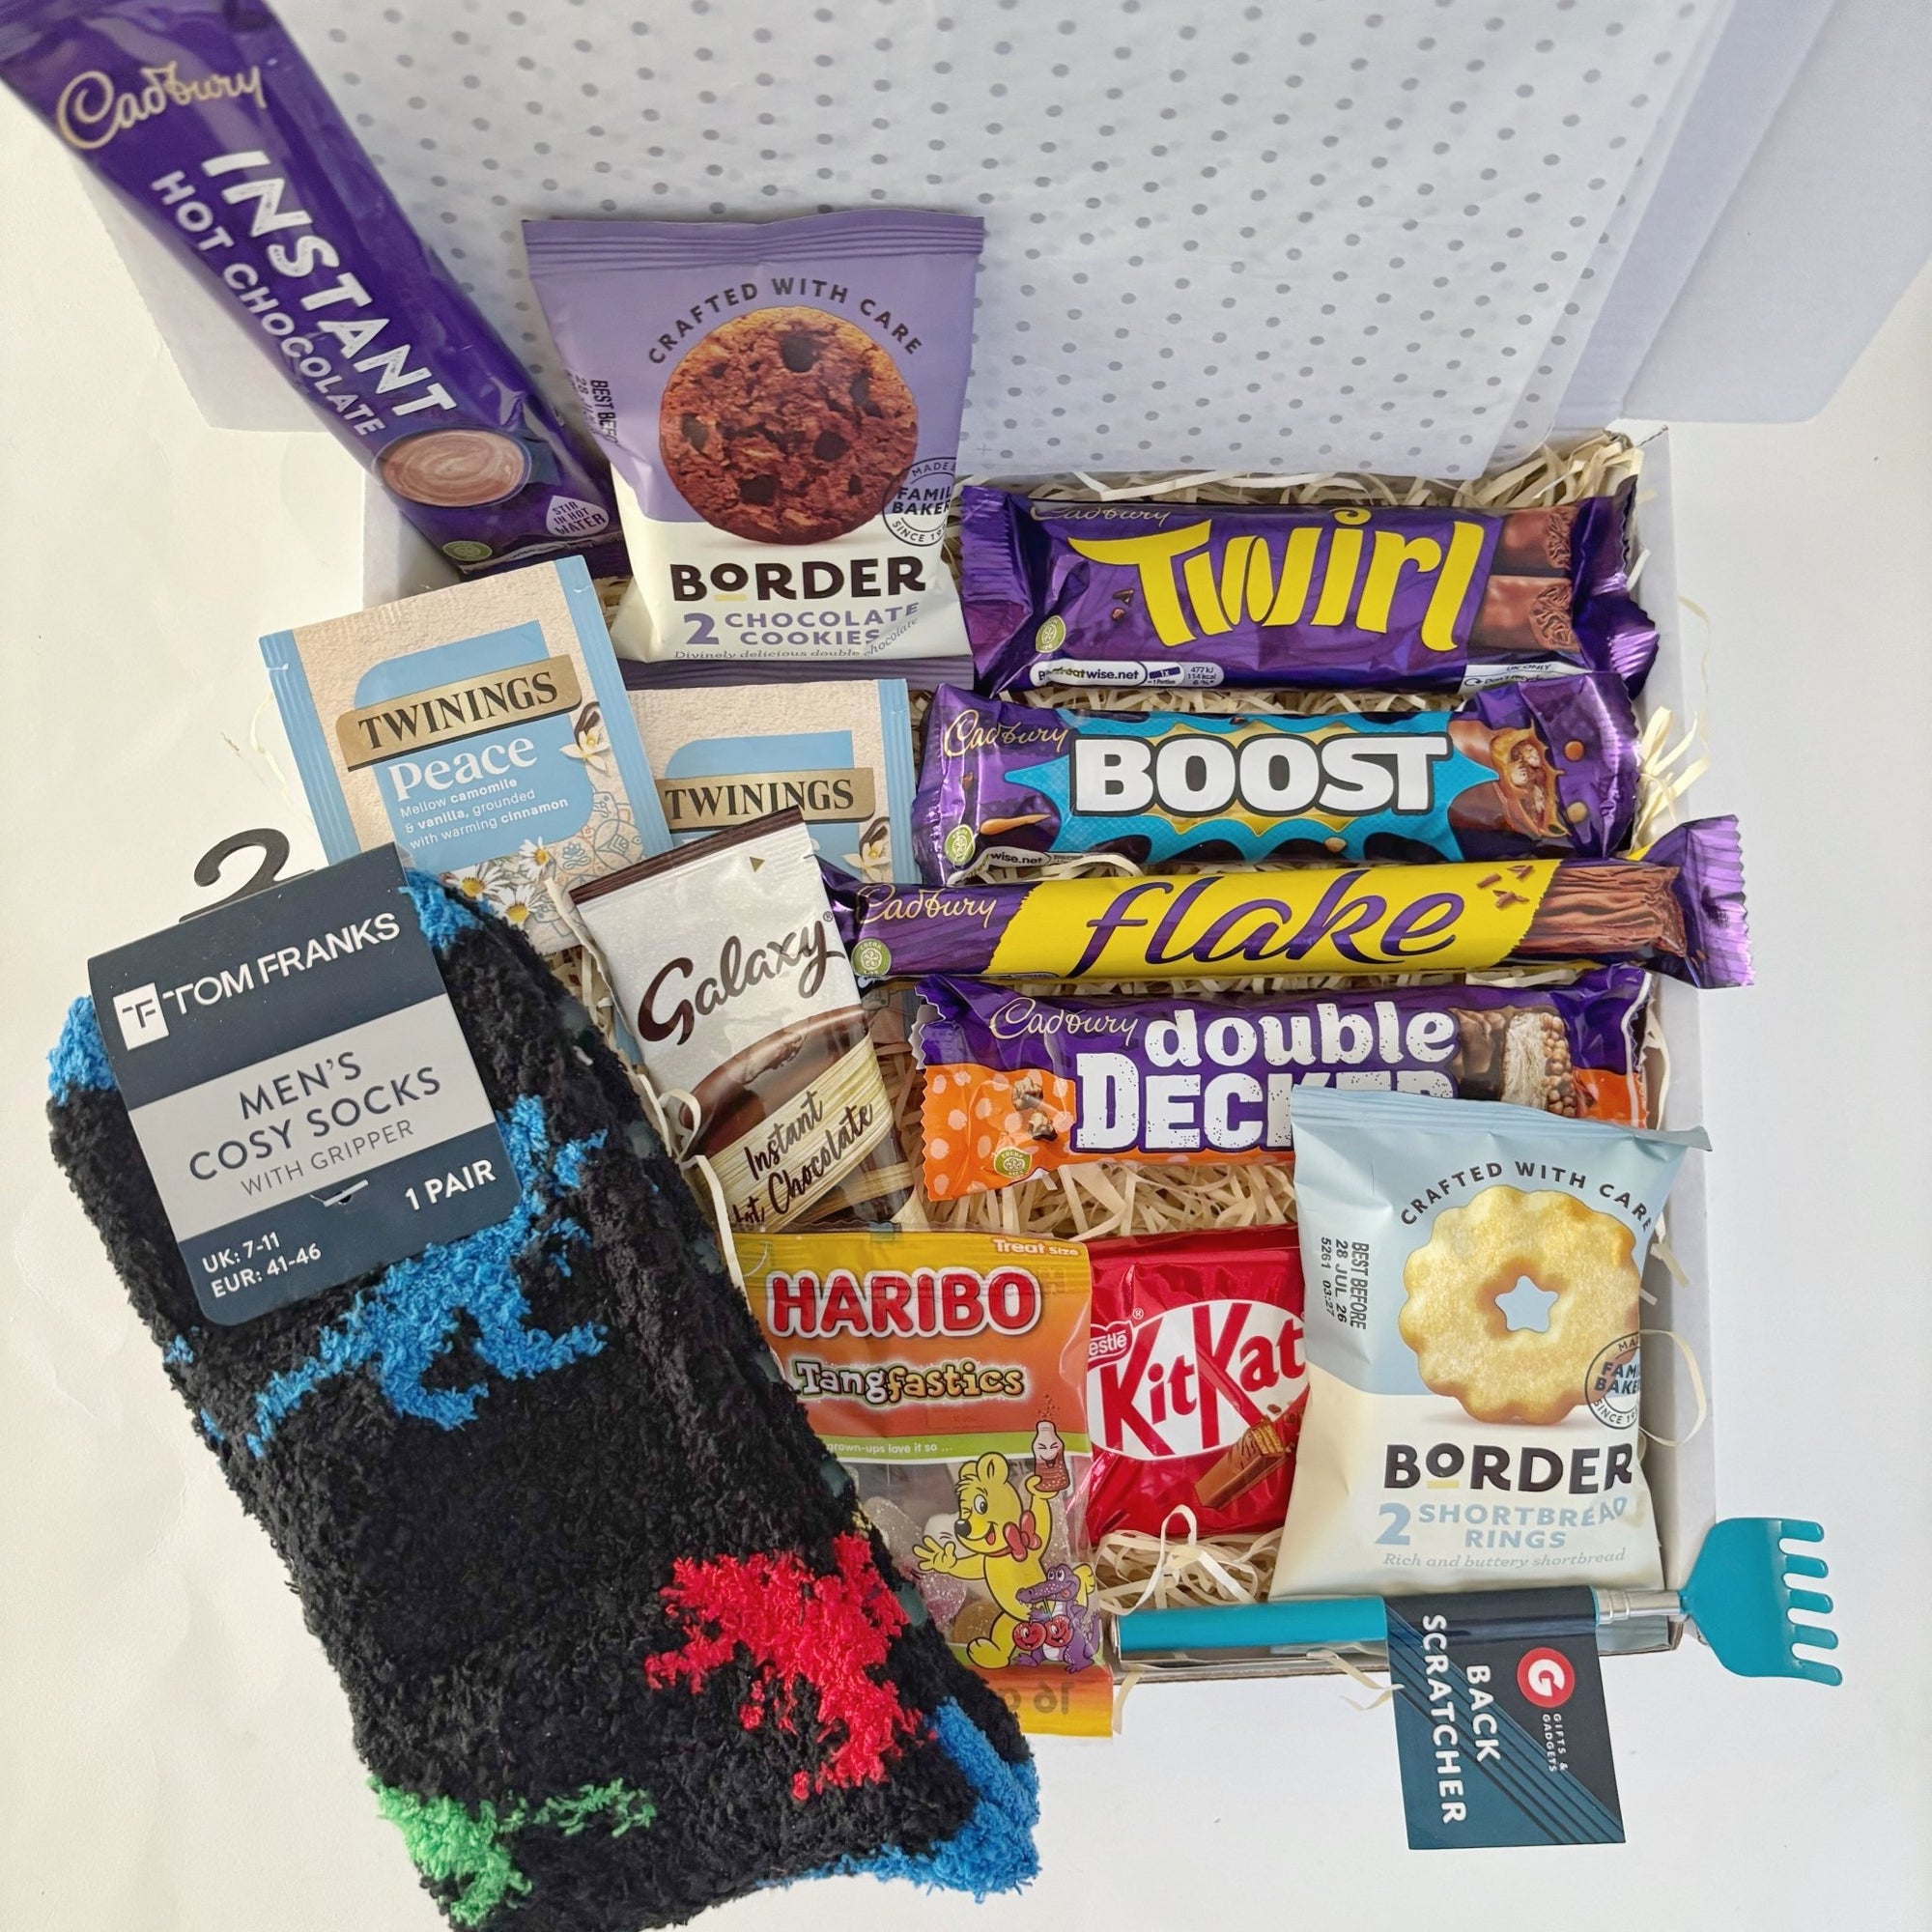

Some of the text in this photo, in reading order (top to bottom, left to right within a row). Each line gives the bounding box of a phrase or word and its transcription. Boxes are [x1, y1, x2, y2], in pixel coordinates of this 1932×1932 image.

[56, 62, 266, 150] Cadbury
[152, 171, 385, 436] HOT CHOCOLATE
[201, 151, 456, 417] INSTANT
[648, 277, 923, 365] CRAFTED WITH CARE
[590, 380, 613, 409] BEST
[912, 462, 949, 477] MADE
[553, 501, 579, 516] STIR
[554, 507, 590, 526] IN HOT
[554, 513, 607, 535] WATER
[892, 520, 925, 542] SINCE
[670, 555, 926, 602] BORDER
[1068, 508, 1484, 653] Twirl
[683, 611, 720, 645] 2
[724, 602, 920, 628] CHOCOLATE
[740, 629, 880, 645] COOKIES
[674, 650, 736, 660] Divinely
[740, 649, 808, 659] delicious
[810, 648, 861, 658] double
[358, 671, 559, 752] TWININGS
[944, 709, 1069, 757] Cadbury
[388, 737, 538, 802] Peace
[1073, 736, 1450, 812] BOOST
[400, 776, 518, 819] Mellow camomile
[406, 788, 536, 834] & vanilla, grounded
[410, 797, 569, 850] with warming cinnamon
[665, 779, 854, 820] TWININGS
[854, 883, 997, 929] Cadbury
[1065, 869, 1465, 979] flake
[162, 963, 254, 1015] TOM
[257, 912, 401, 984] FRANKS
[637, 918, 846, 1045] Galaxy
[989, 997, 1139, 1046] Cadbury
[1144, 1001, 1457, 1066] double
[239, 1050, 362, 1121] MEN'S
[1075, 1052, 1454, 1150] DECK
[189, 1065, 441, 1180] COSY SOCKS
[744, 1090, 823, 1181] Instant
[241, 1119, 414, 1197] WITH GRIPPER
[767, 1103, 873, 1215] Chocolate
[405, 1159, 497, 1211] 1 PAIR
[1400, 1160, 1503, 1226] CRAFTED
[1515, 1160, 1586, 1191] WITH
[202, 1232, 281, 1274] UK: 7-11
[211, 1242, 322, 1298] EUR: 41-46
[993, 1238, 1046, 1254] Treat
[771, 1269, 1040, 1337] HARIBO
[1321, 1236, 1335, 1318] 5261 03:27
[1334, 1238, 1349, 1323] 28 JUL 26
[1350, 1241, 1370, 1330] BEST BEFORE
[795, 1360, 1024, 1405] Tangfastics
[1099, 1302, 1305, 1457] KitKat
[1593, 1399, 1623, 1425] SINCE
[826, 1443, 886, 1455] grown-ups
[888, 1442, 911, 1453] love
[914, 1442, 923, 1453] it
[1384, 1442, 1633, 1494] BORDER
[1375, 1502, 1411, 1546] 2
[1417, 1495, 1629, 1527] SHORTBREAD
[1383, 1548, 1626, 1570] Rich and buttery shortbread
[1464, 1528, 1567, 1549] RINGS
[1527, 1659, 1566, 1697] G
[1422, 1614, 1467, 1824] SCRATCHER
[1465, 1664, 1501, 1763] BACK
[1552, 1713, 1567, 1755] GIFTS
[1542, 1714, 1557, 1773] GADGETS
